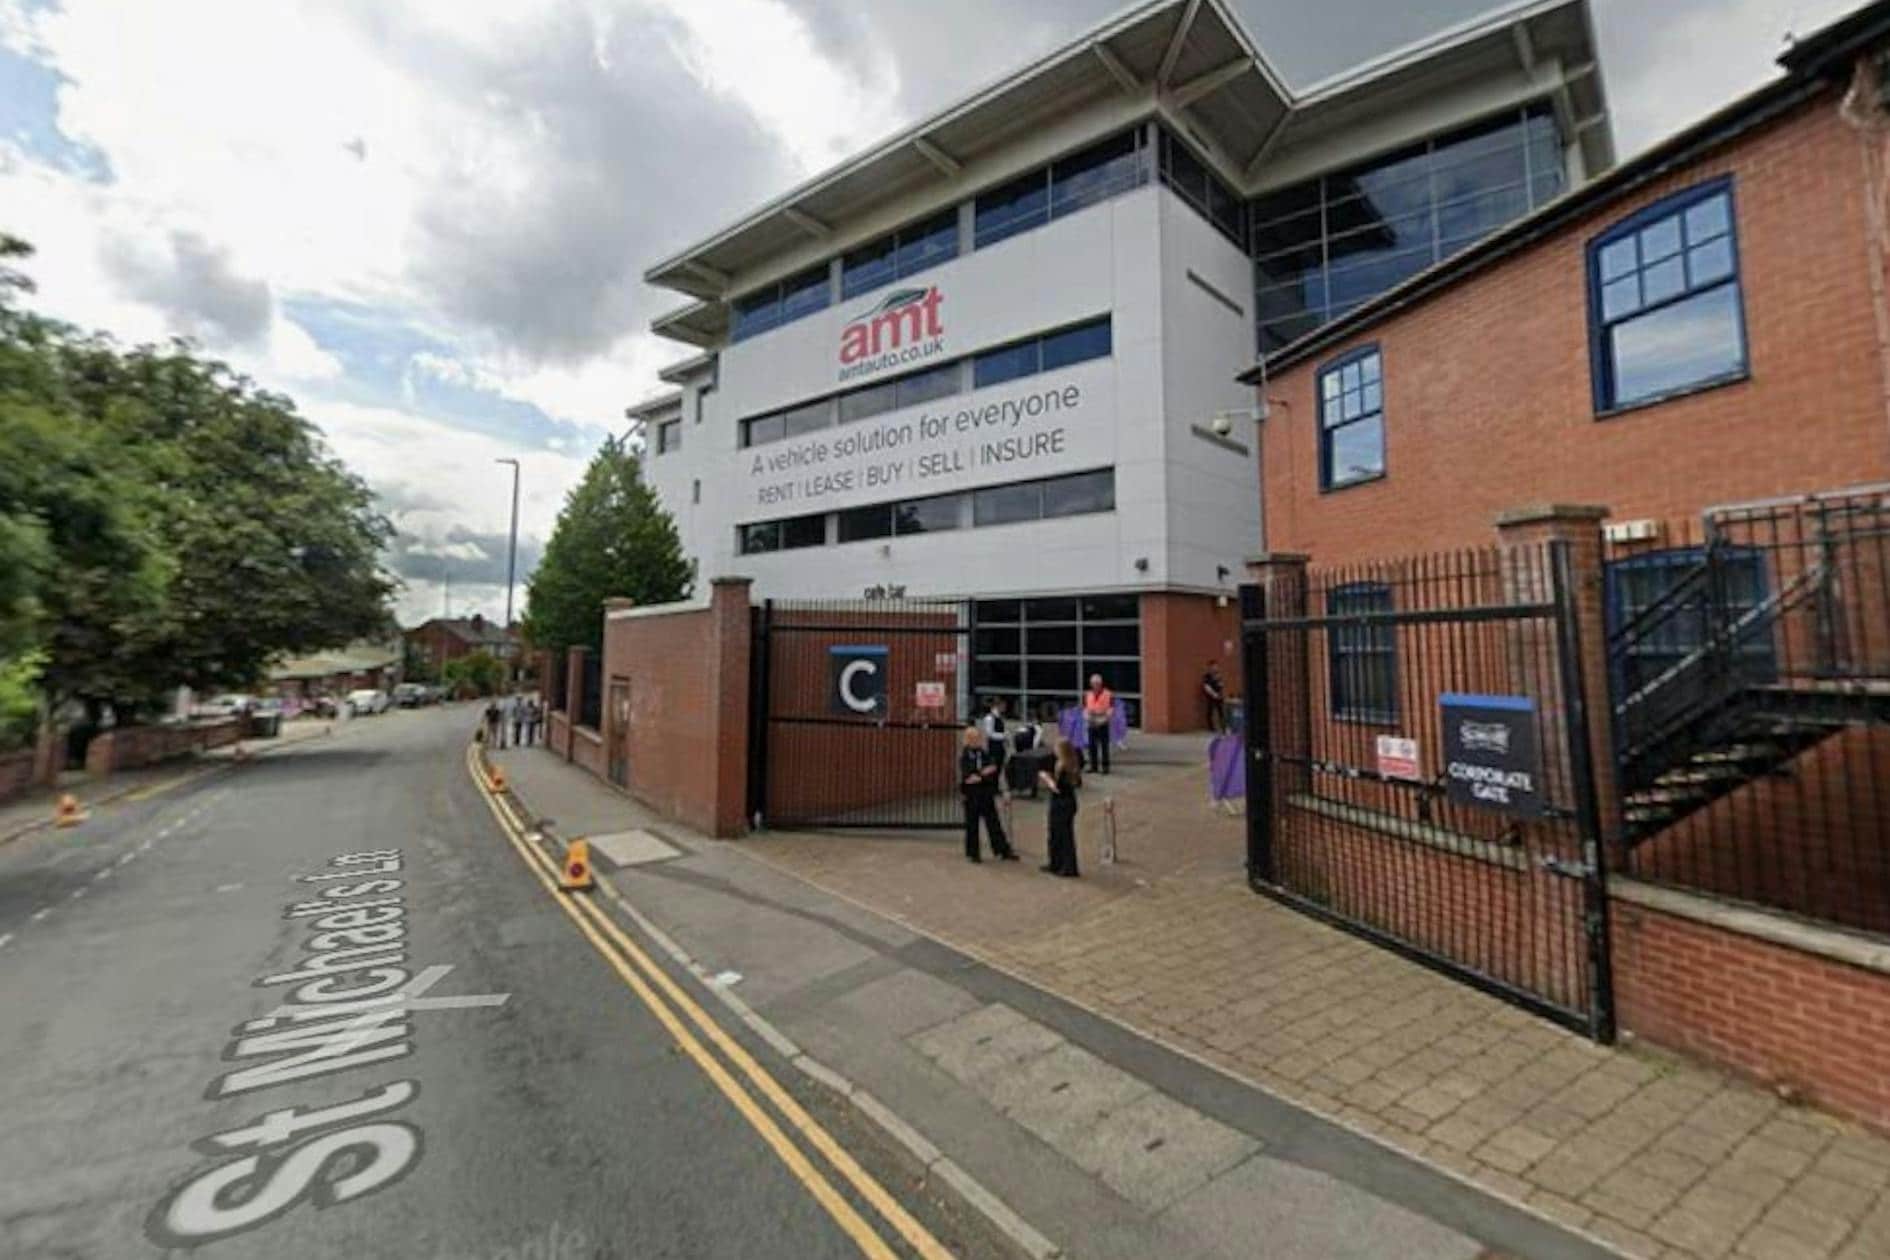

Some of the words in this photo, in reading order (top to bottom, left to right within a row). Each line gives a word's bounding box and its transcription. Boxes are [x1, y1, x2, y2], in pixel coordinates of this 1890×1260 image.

[838, 339, 943, 380] amtauto.co.uk
[839, 286, 943, 364] amt
[751, 454, 764, 475] A
[768, 441, 828, 472] vehicle
[833, 424, 913, 459] solution
[919, 413, 950, 441] for
[955, 384, 1081, 431] everyone
[758, 482, 794, 505] RENT
[805, 469, 854, 498] LEASE
[866, 462, 904, 487] BUY
[918, 450, 965, 478] SELL
[980, 428, 1066, 466] INSURE
[839, 659, 878, 713] C
